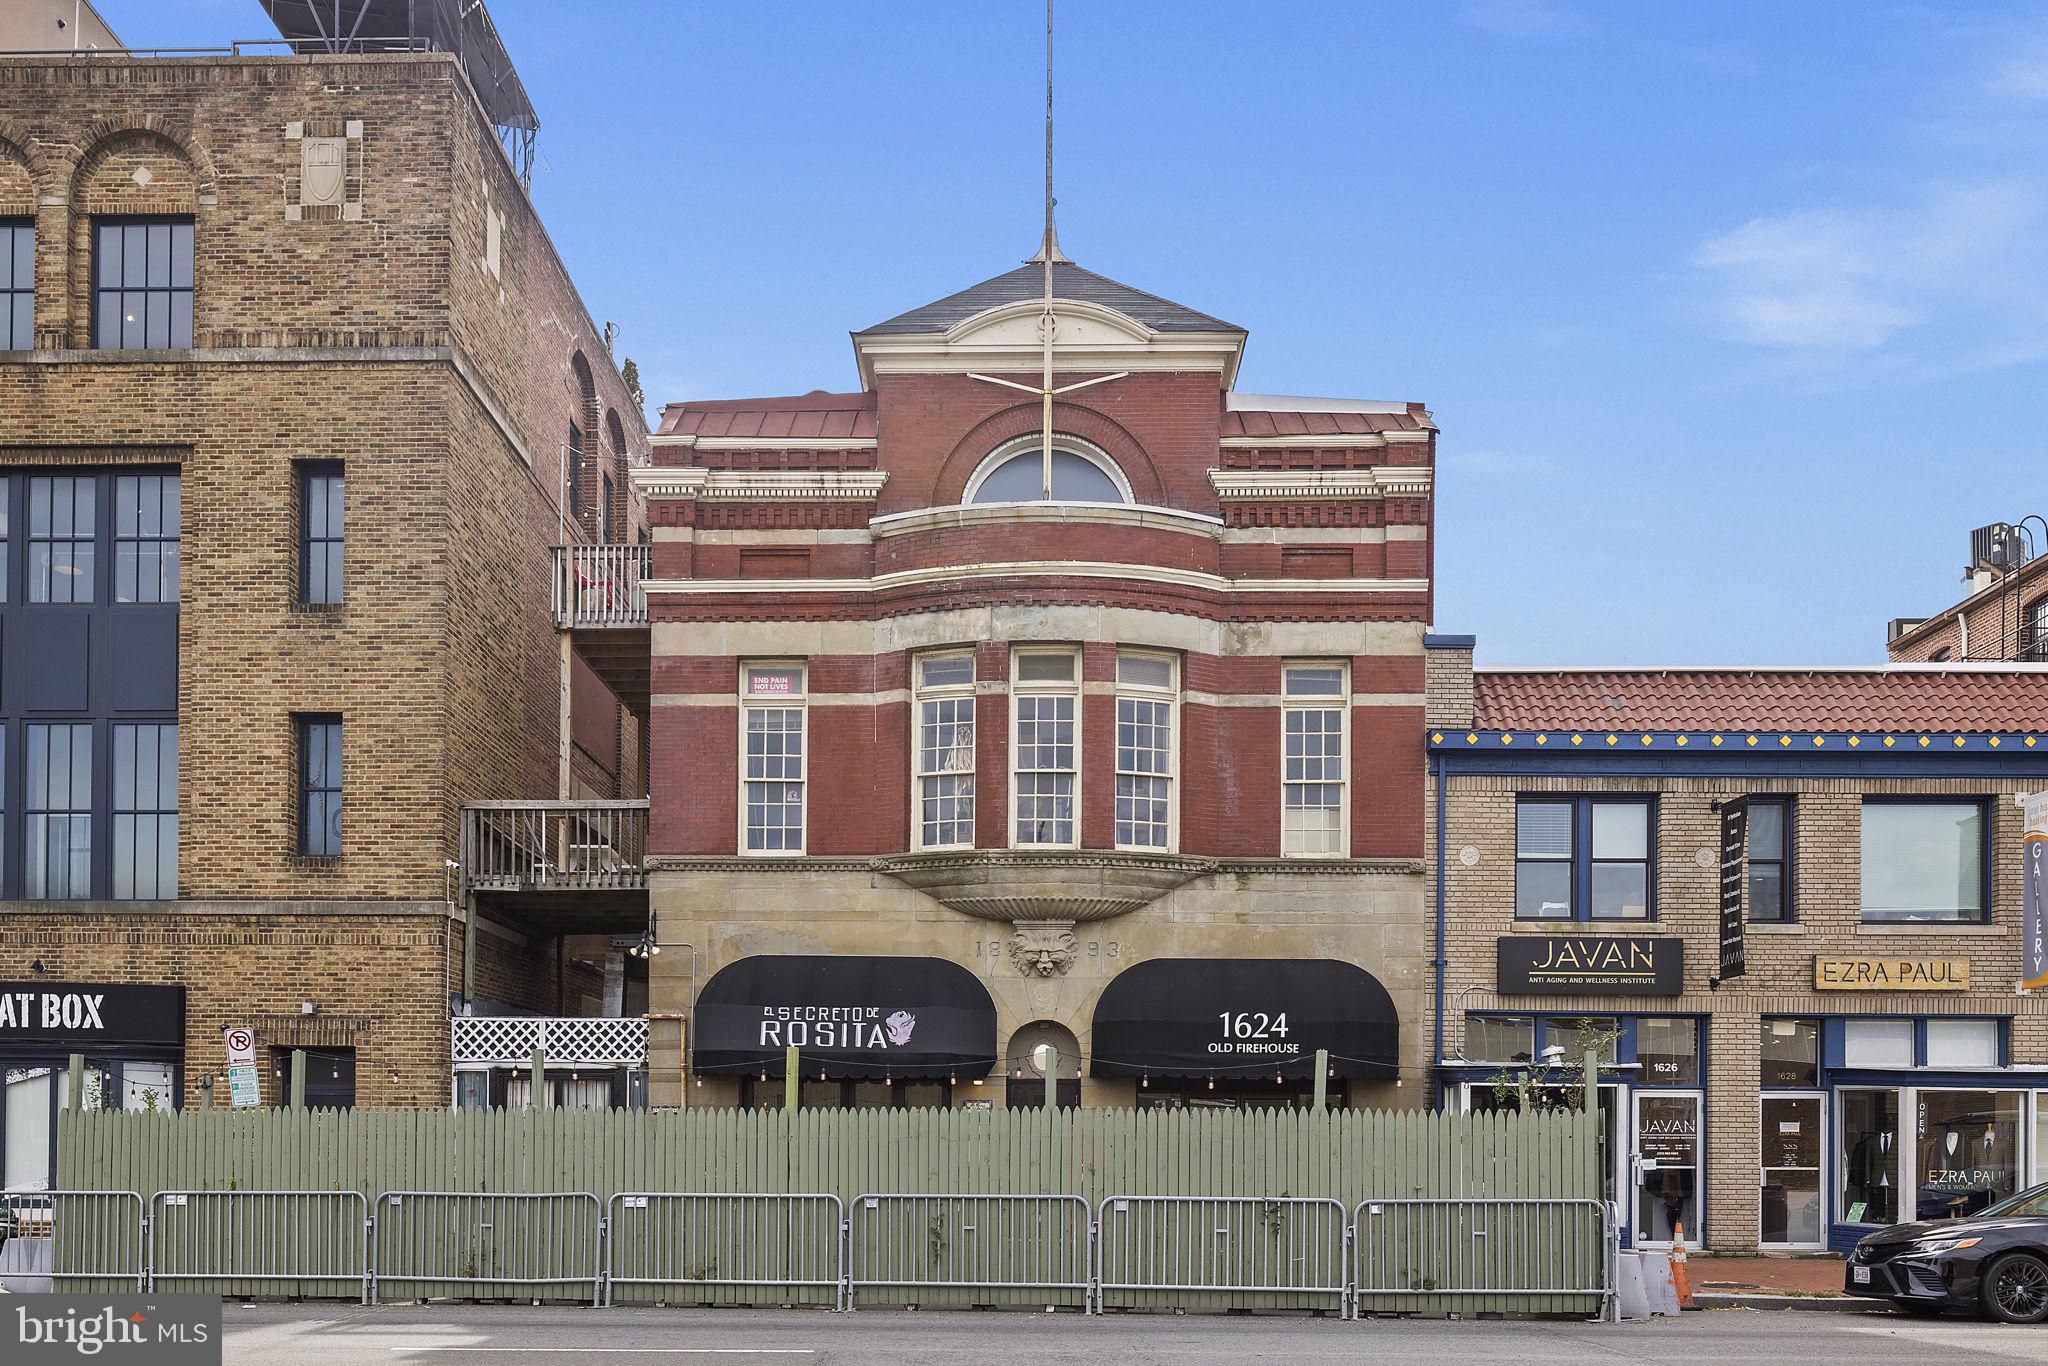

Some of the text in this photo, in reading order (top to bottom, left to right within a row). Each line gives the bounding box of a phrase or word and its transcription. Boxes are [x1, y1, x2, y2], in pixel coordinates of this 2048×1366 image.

[2032, 842, 2043, 972] GALLERY
[1532, 940, 1653, 969] JAVAN
[1721, 949, 1744, 967] JAVAN
[1824, 962, 1962, 983] EZRA PAUL
[0, 993, 105, 1029] AT BOX
[764, 1007, 880, 1022] EL SECRETO DE
[1219, 1011, 1289, 1038] 1624
[760, 1020, 888, 1049] ROSITA
[1207, 1043, 1300, 1053] OLD FIREHOUSE
[1653, 1063, 1678, 1072] 1626
[1777, 1072, 1797, 1080] 1628
[1639, 1119, 1695, 1133] JAVAN
[1928, 1170, 1968, 1183] EZRA
